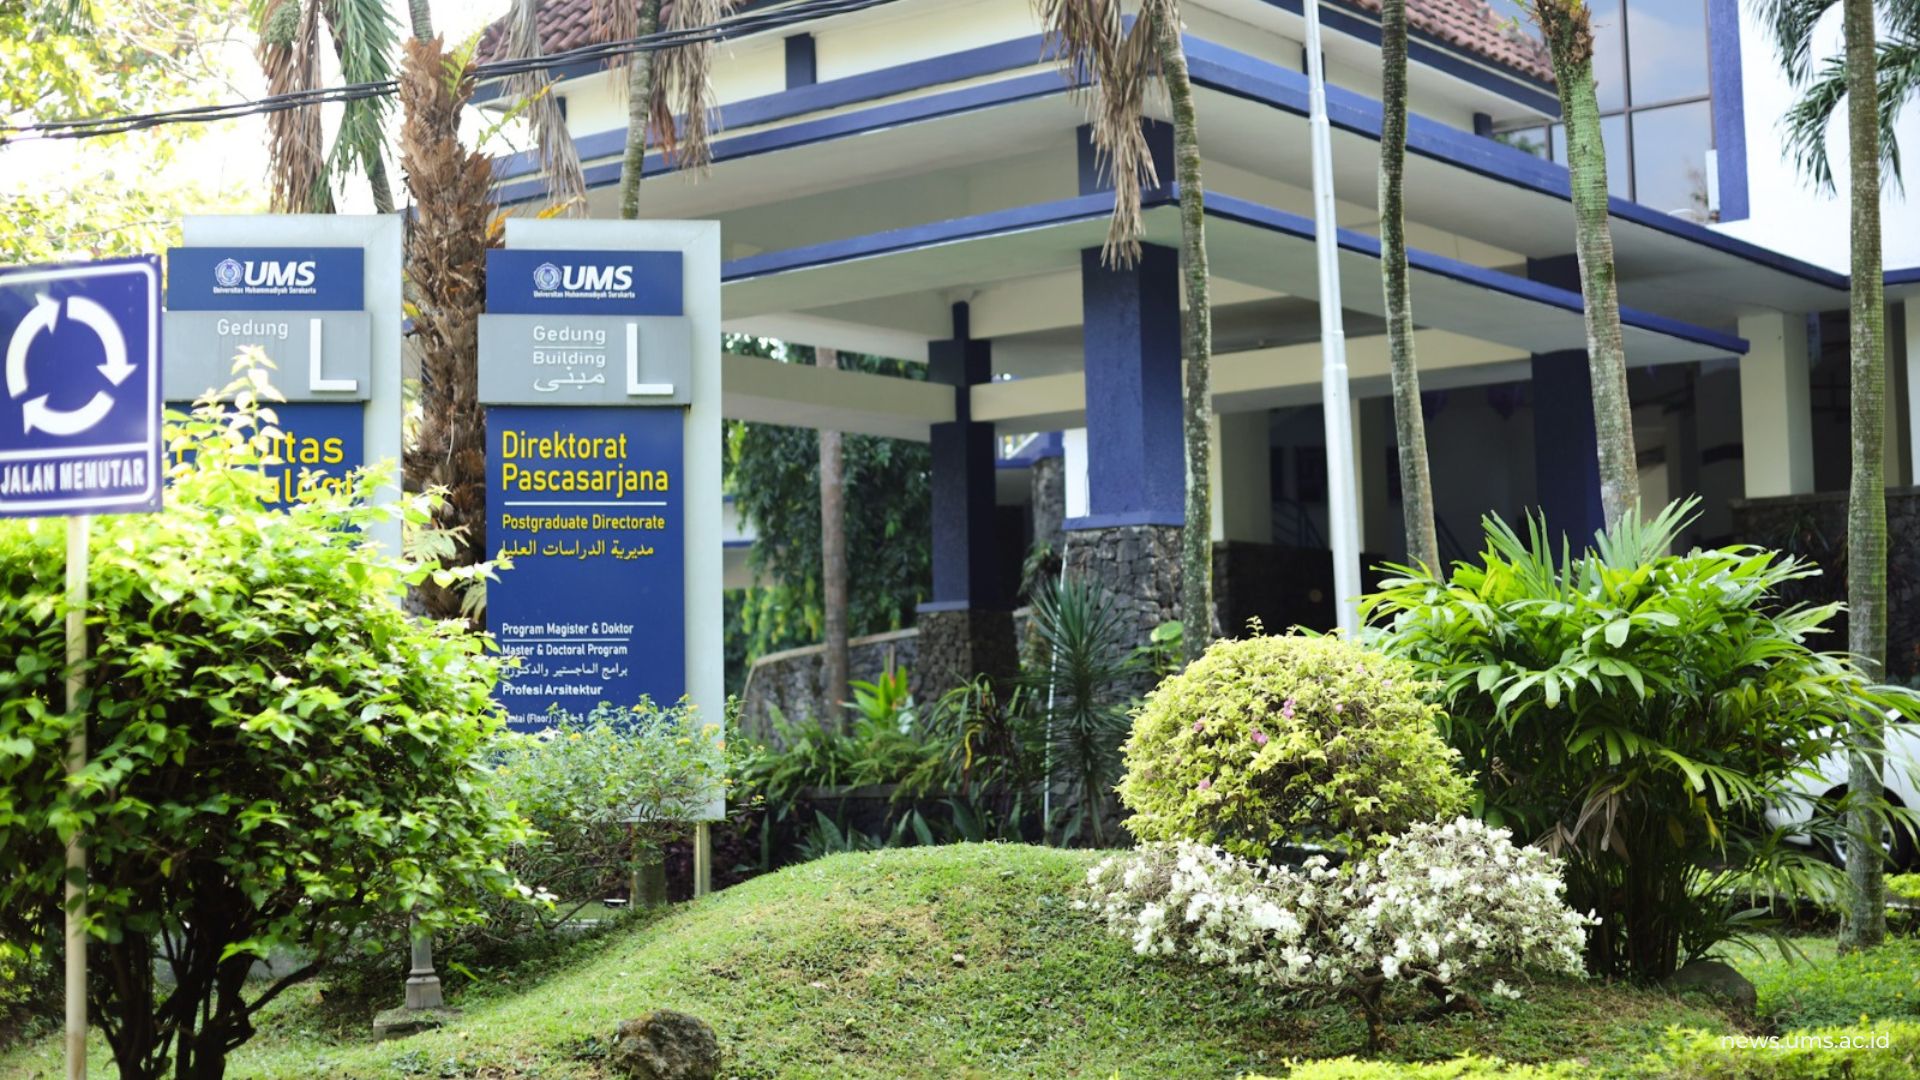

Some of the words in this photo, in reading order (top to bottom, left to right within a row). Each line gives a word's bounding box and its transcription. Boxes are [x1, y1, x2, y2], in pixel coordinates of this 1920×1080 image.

[243, 261, 317, 287] UMS
[562, 265, 634, 290] UMS
[216, 319, 289, 339] Gedung
[533, 325, 606, 345] Gedung
[309, 318, 357, 391] L
[533, 351, 606, 367] Building
[626, 323, 674, 395] L
[502, 430, 627, 459] Direktorat
[0, 462, 56, 496] JALAN
[59, 457, 145, 491] MEMUTAR
[502, 463, 669, 498] Pascasarjana
[502, 514, 588, 533] Postgraduate
[592, 514, 665, 529] Directorate
[542, 539, 606, 560] الدراسات
[611, 539, 654, 560] مديرية
[502, 622, 545, 638] Program
[546, 622, 589, 638] Magister
[591, 622, 599, 635] &
[601, 622, 634, 635] Doktor
[502, 644, 535, 656] Master
[536, 644, 544, 656] &
[545, 643, 586, 656] Doctoral
[587, 643, 628, 658] Program
[502, 684, 543, 696] Profesi
[544, 684, 604, 696] Arsitektur
[506, 713, 525, 724] antai
